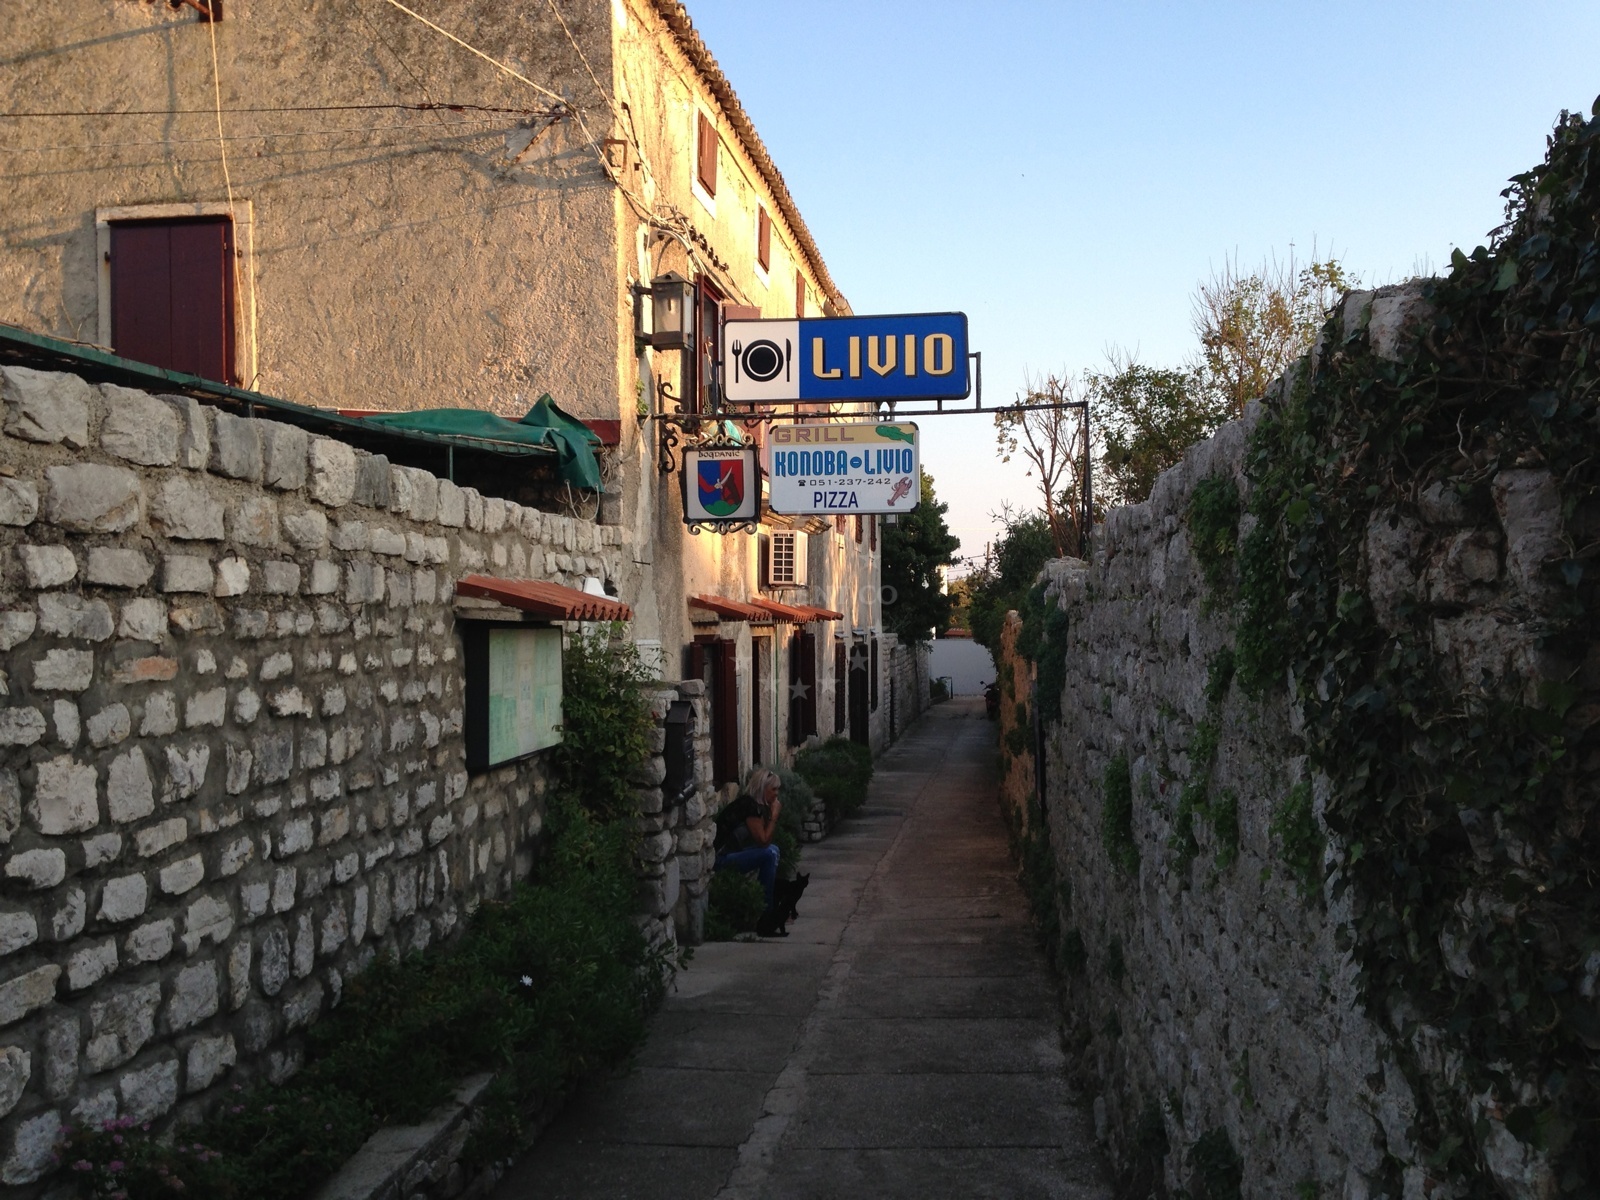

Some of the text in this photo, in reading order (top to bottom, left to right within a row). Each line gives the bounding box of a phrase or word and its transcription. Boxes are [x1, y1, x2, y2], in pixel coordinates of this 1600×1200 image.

[812, 333, 955, 379] LIVIO
[774, 427, 854, 443] GRILL
[775, 448, 913, 477] KONOBA LIVIO
[810, 478, 891, 487] 051-237-242
[813, 491, 859, 508] PIZZA
